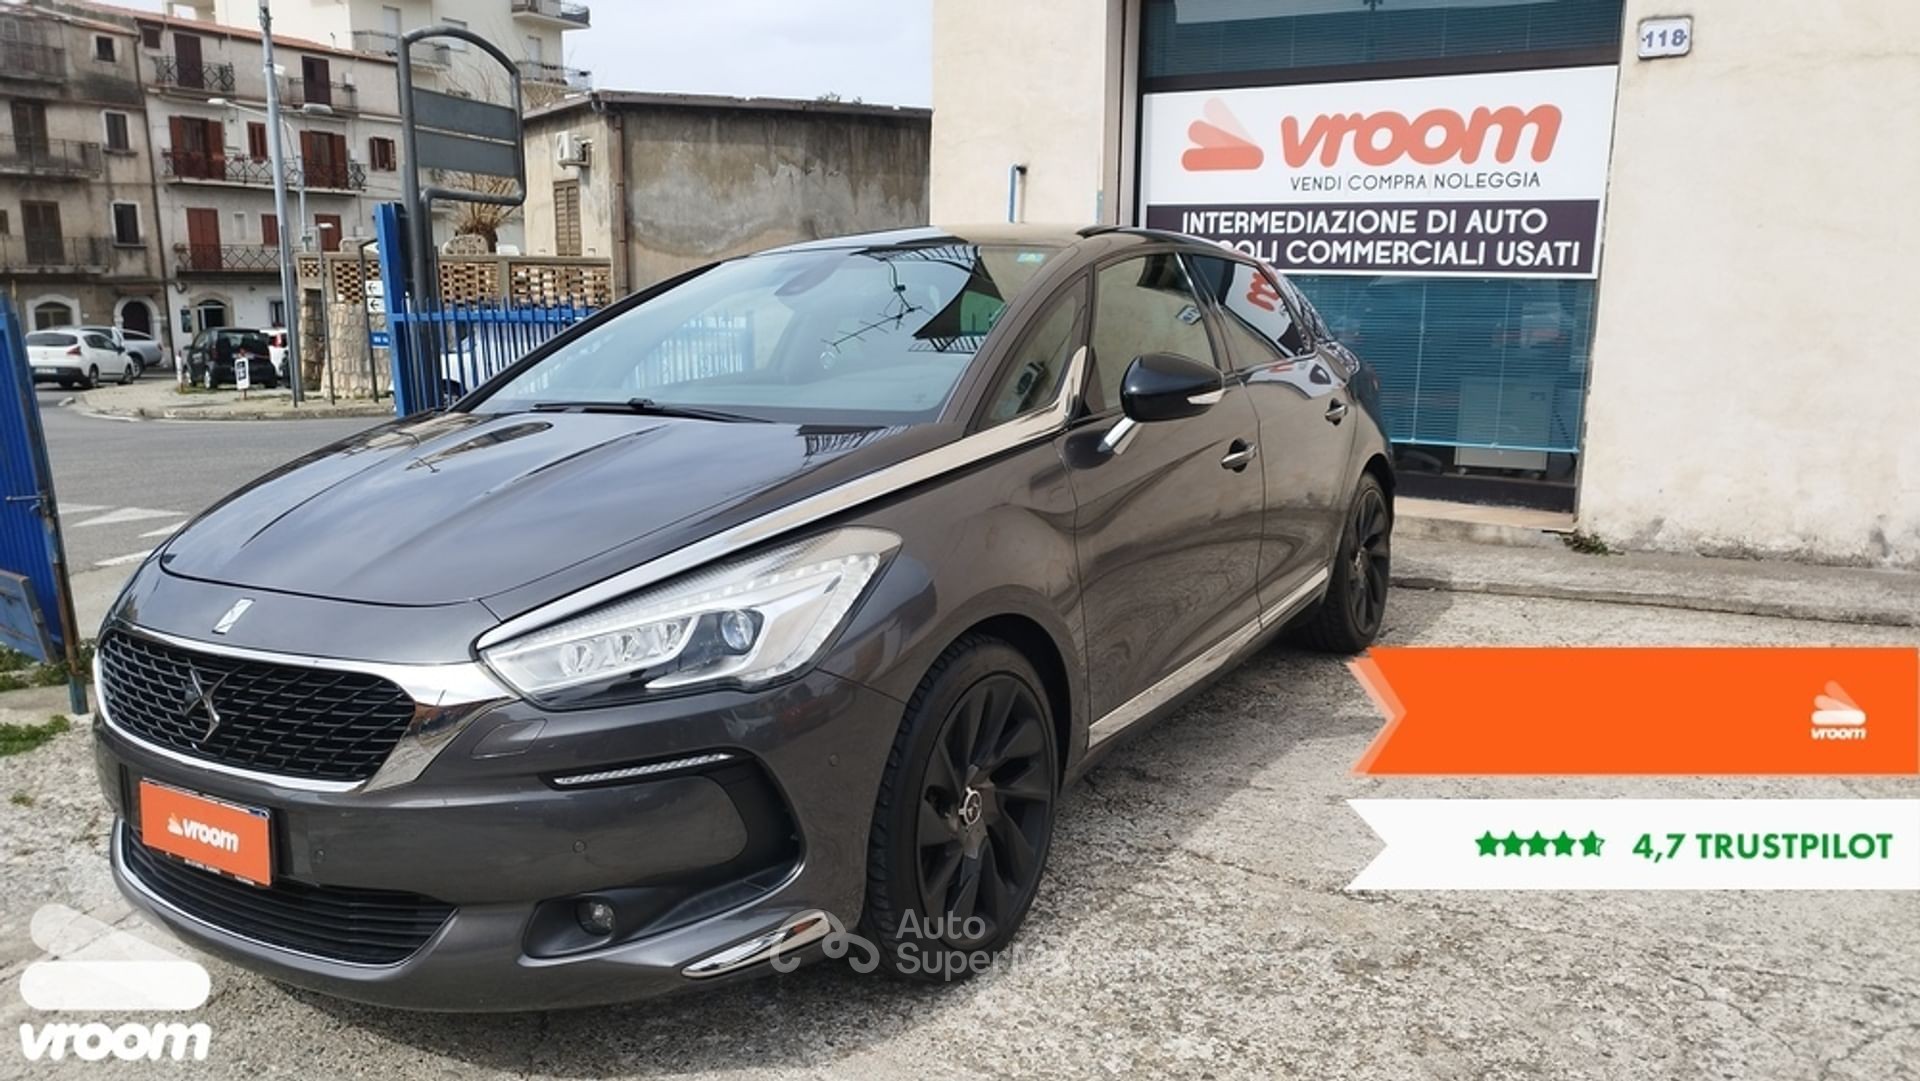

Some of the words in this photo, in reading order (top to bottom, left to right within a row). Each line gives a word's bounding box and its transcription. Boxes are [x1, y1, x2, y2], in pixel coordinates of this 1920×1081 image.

[1645, 28, 1686, 48] 118
[1281, 104, 1562, 168] vroom
[1290, 176, 1341, 191] VENDI
[1348, 174, 1427, 190] COMPRA
[1434, 171, 1541, 189] NOLEGGIA
[1182, 209, 1418, 235] INTERMEDIAZIONE
[1426, 209, 1457, 234] DI
[1464, 208, 1548, 234] AUTO
[1286, 239, 1486, 265] COMMERCIALI
[1496, 241, 1580, 266] USATI
[182, 817, 240, 853] vroom
